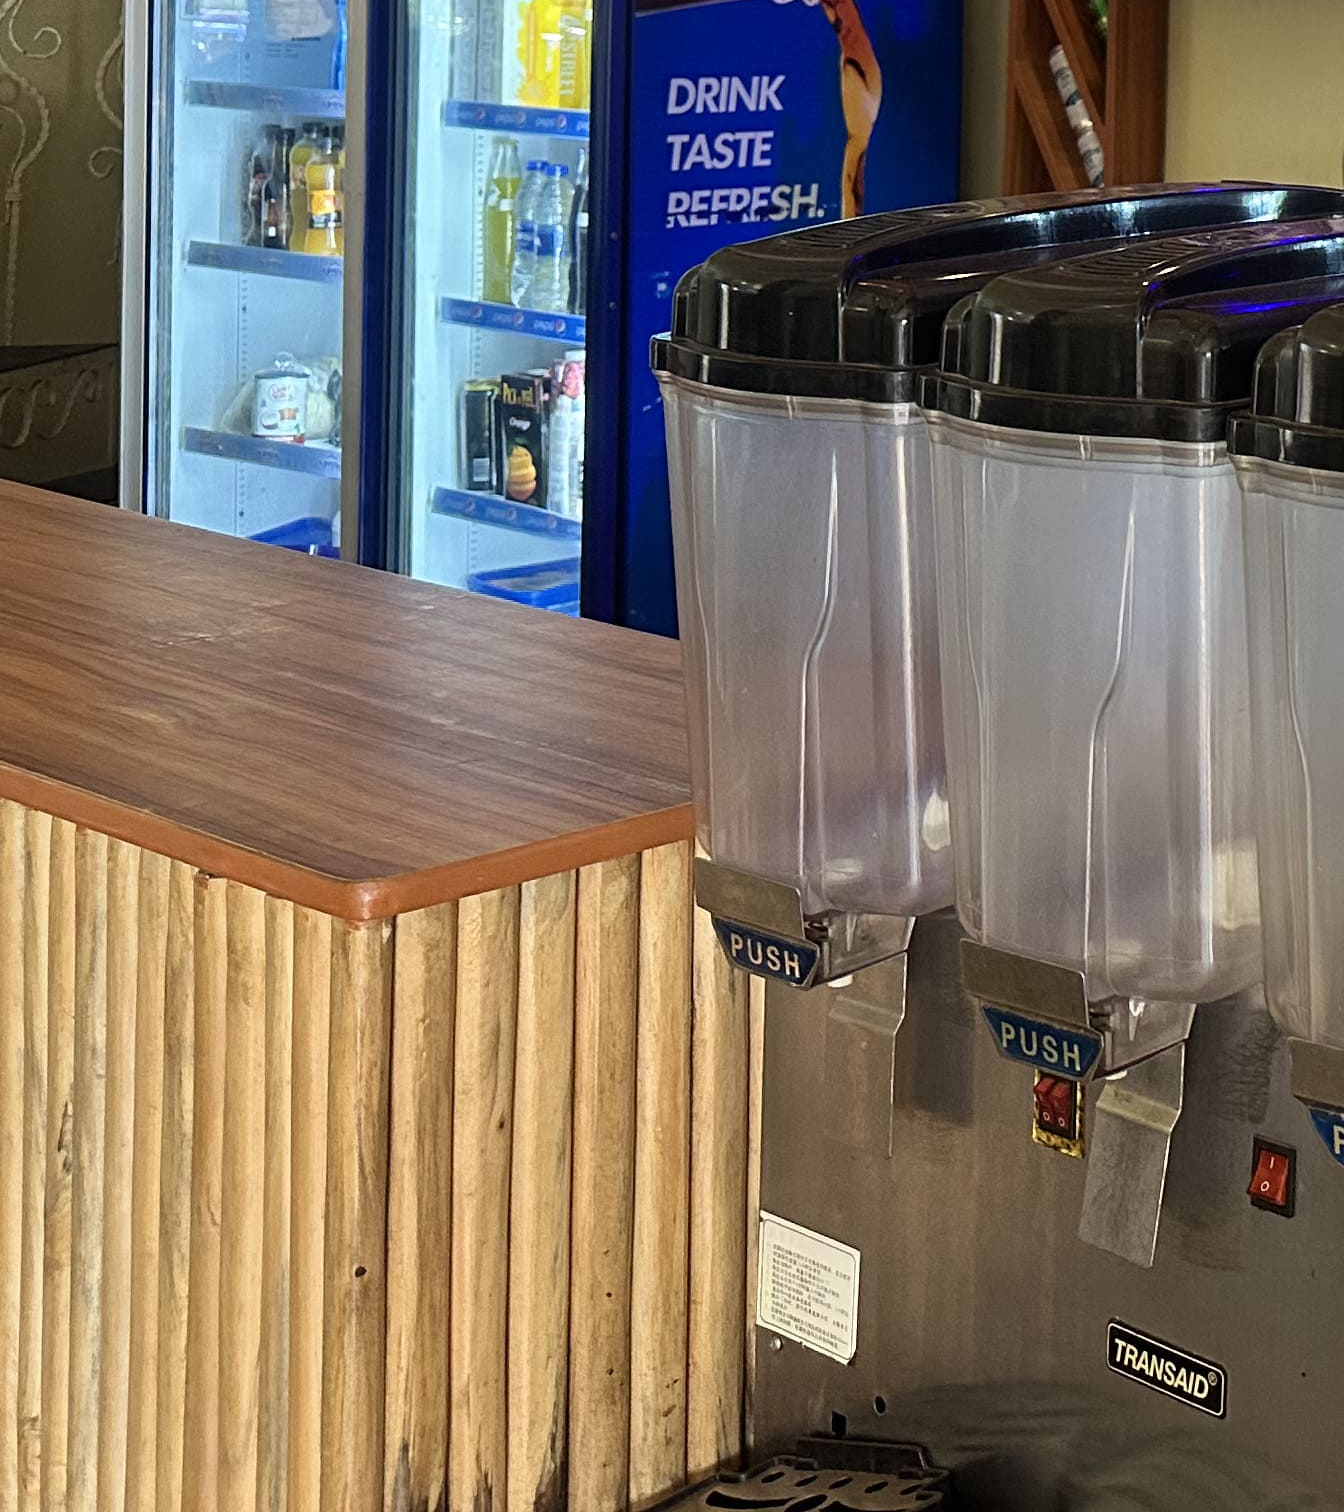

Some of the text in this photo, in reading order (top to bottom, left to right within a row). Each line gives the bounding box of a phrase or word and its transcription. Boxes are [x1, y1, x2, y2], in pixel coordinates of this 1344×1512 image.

[666, 73, 787, 116] DRINK
[666, 129, 775, 172] TASTE
[728, 930, 803, 980] PUSH
[1000, 1020, 1085, 1073] PUSH
[1113, 1336, 1211, 1402] TRANSAID
